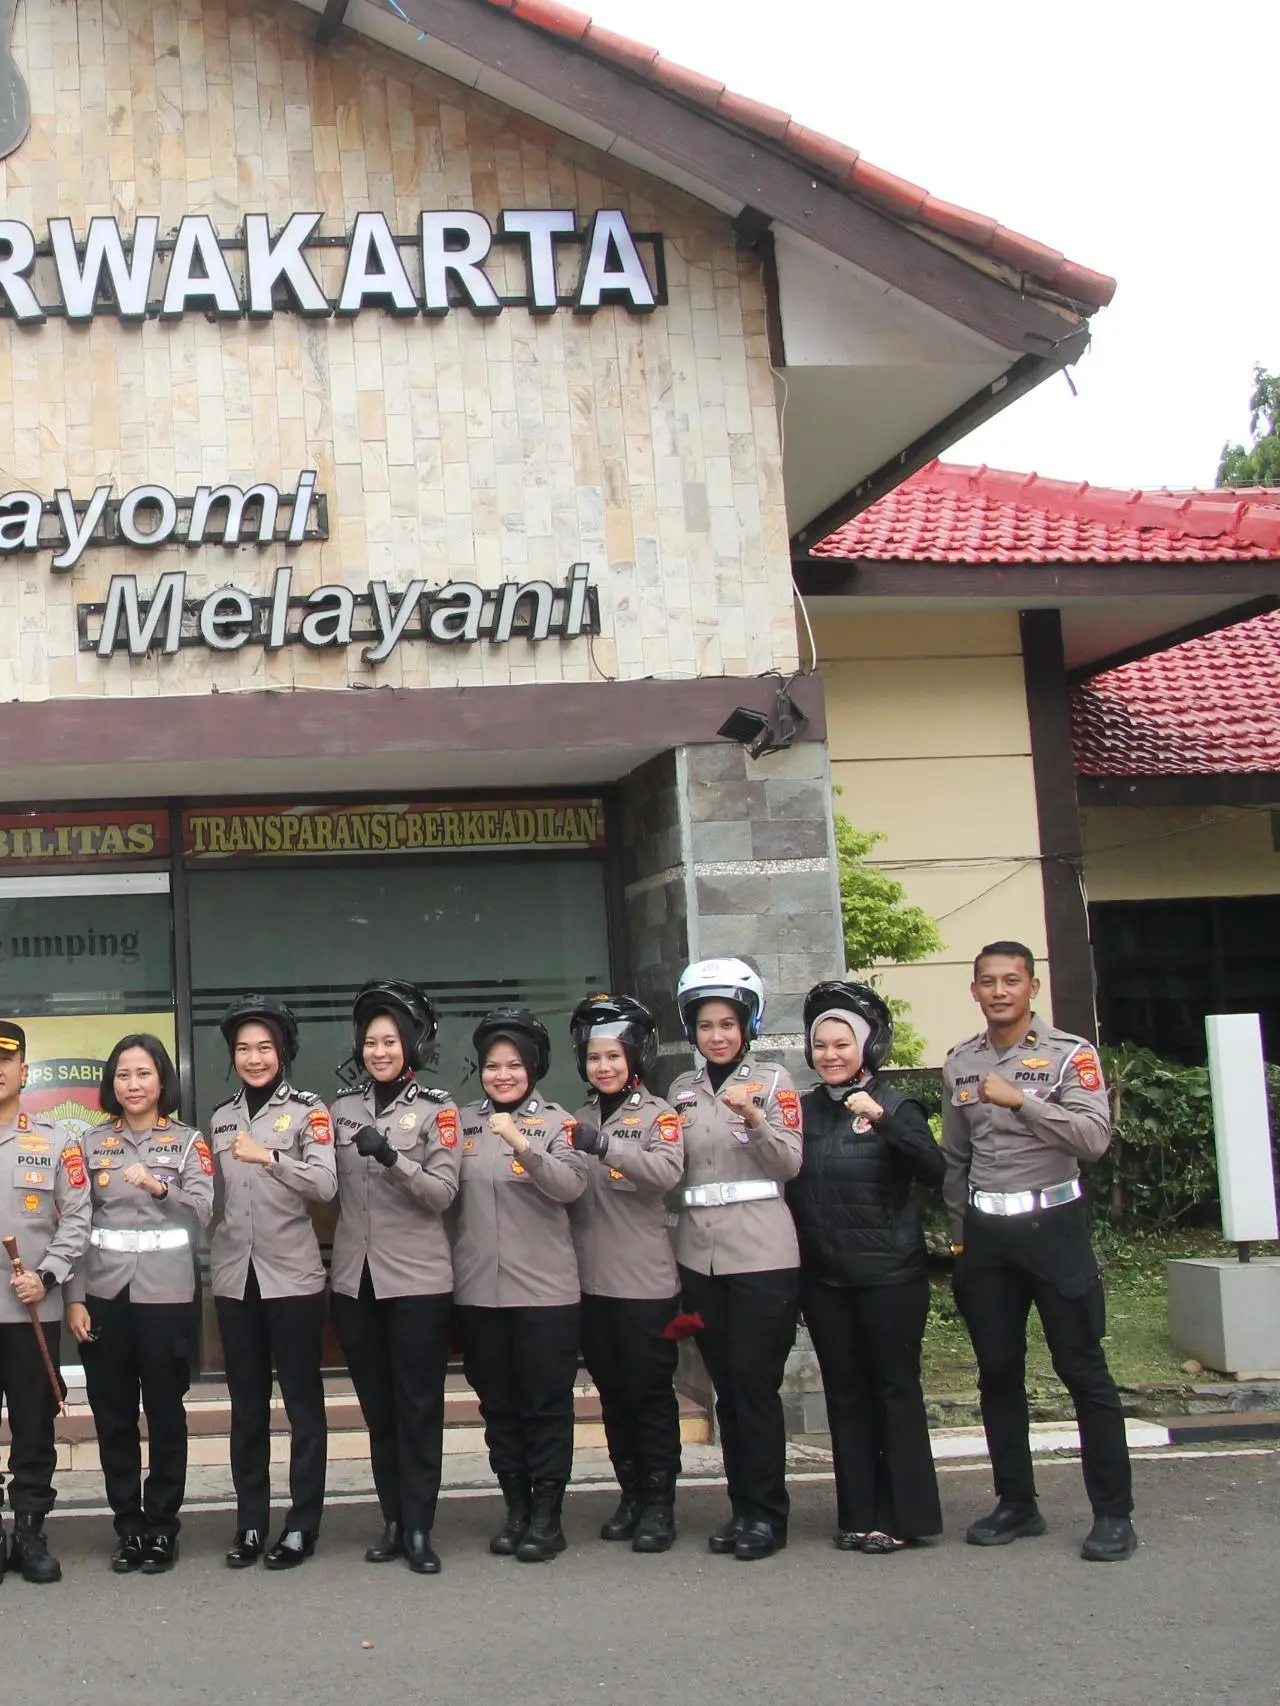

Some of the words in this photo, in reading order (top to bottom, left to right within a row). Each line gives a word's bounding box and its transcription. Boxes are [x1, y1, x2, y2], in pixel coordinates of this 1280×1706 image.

[96, 562, 590, 665] Melayani
[190, 813, 400, 852] TRANSPARANSI
[405, 807, 599, 849] BERKEADILAN
[1015, 1071, 1049, 1081] POLRI
[520, 1128, 545, 1137] OLRI
[612, 1129, 642, 1139] POLRI
[148, 1145, 182, 1153] POLRI
[18, 1155, 51, 1166] POLRI
